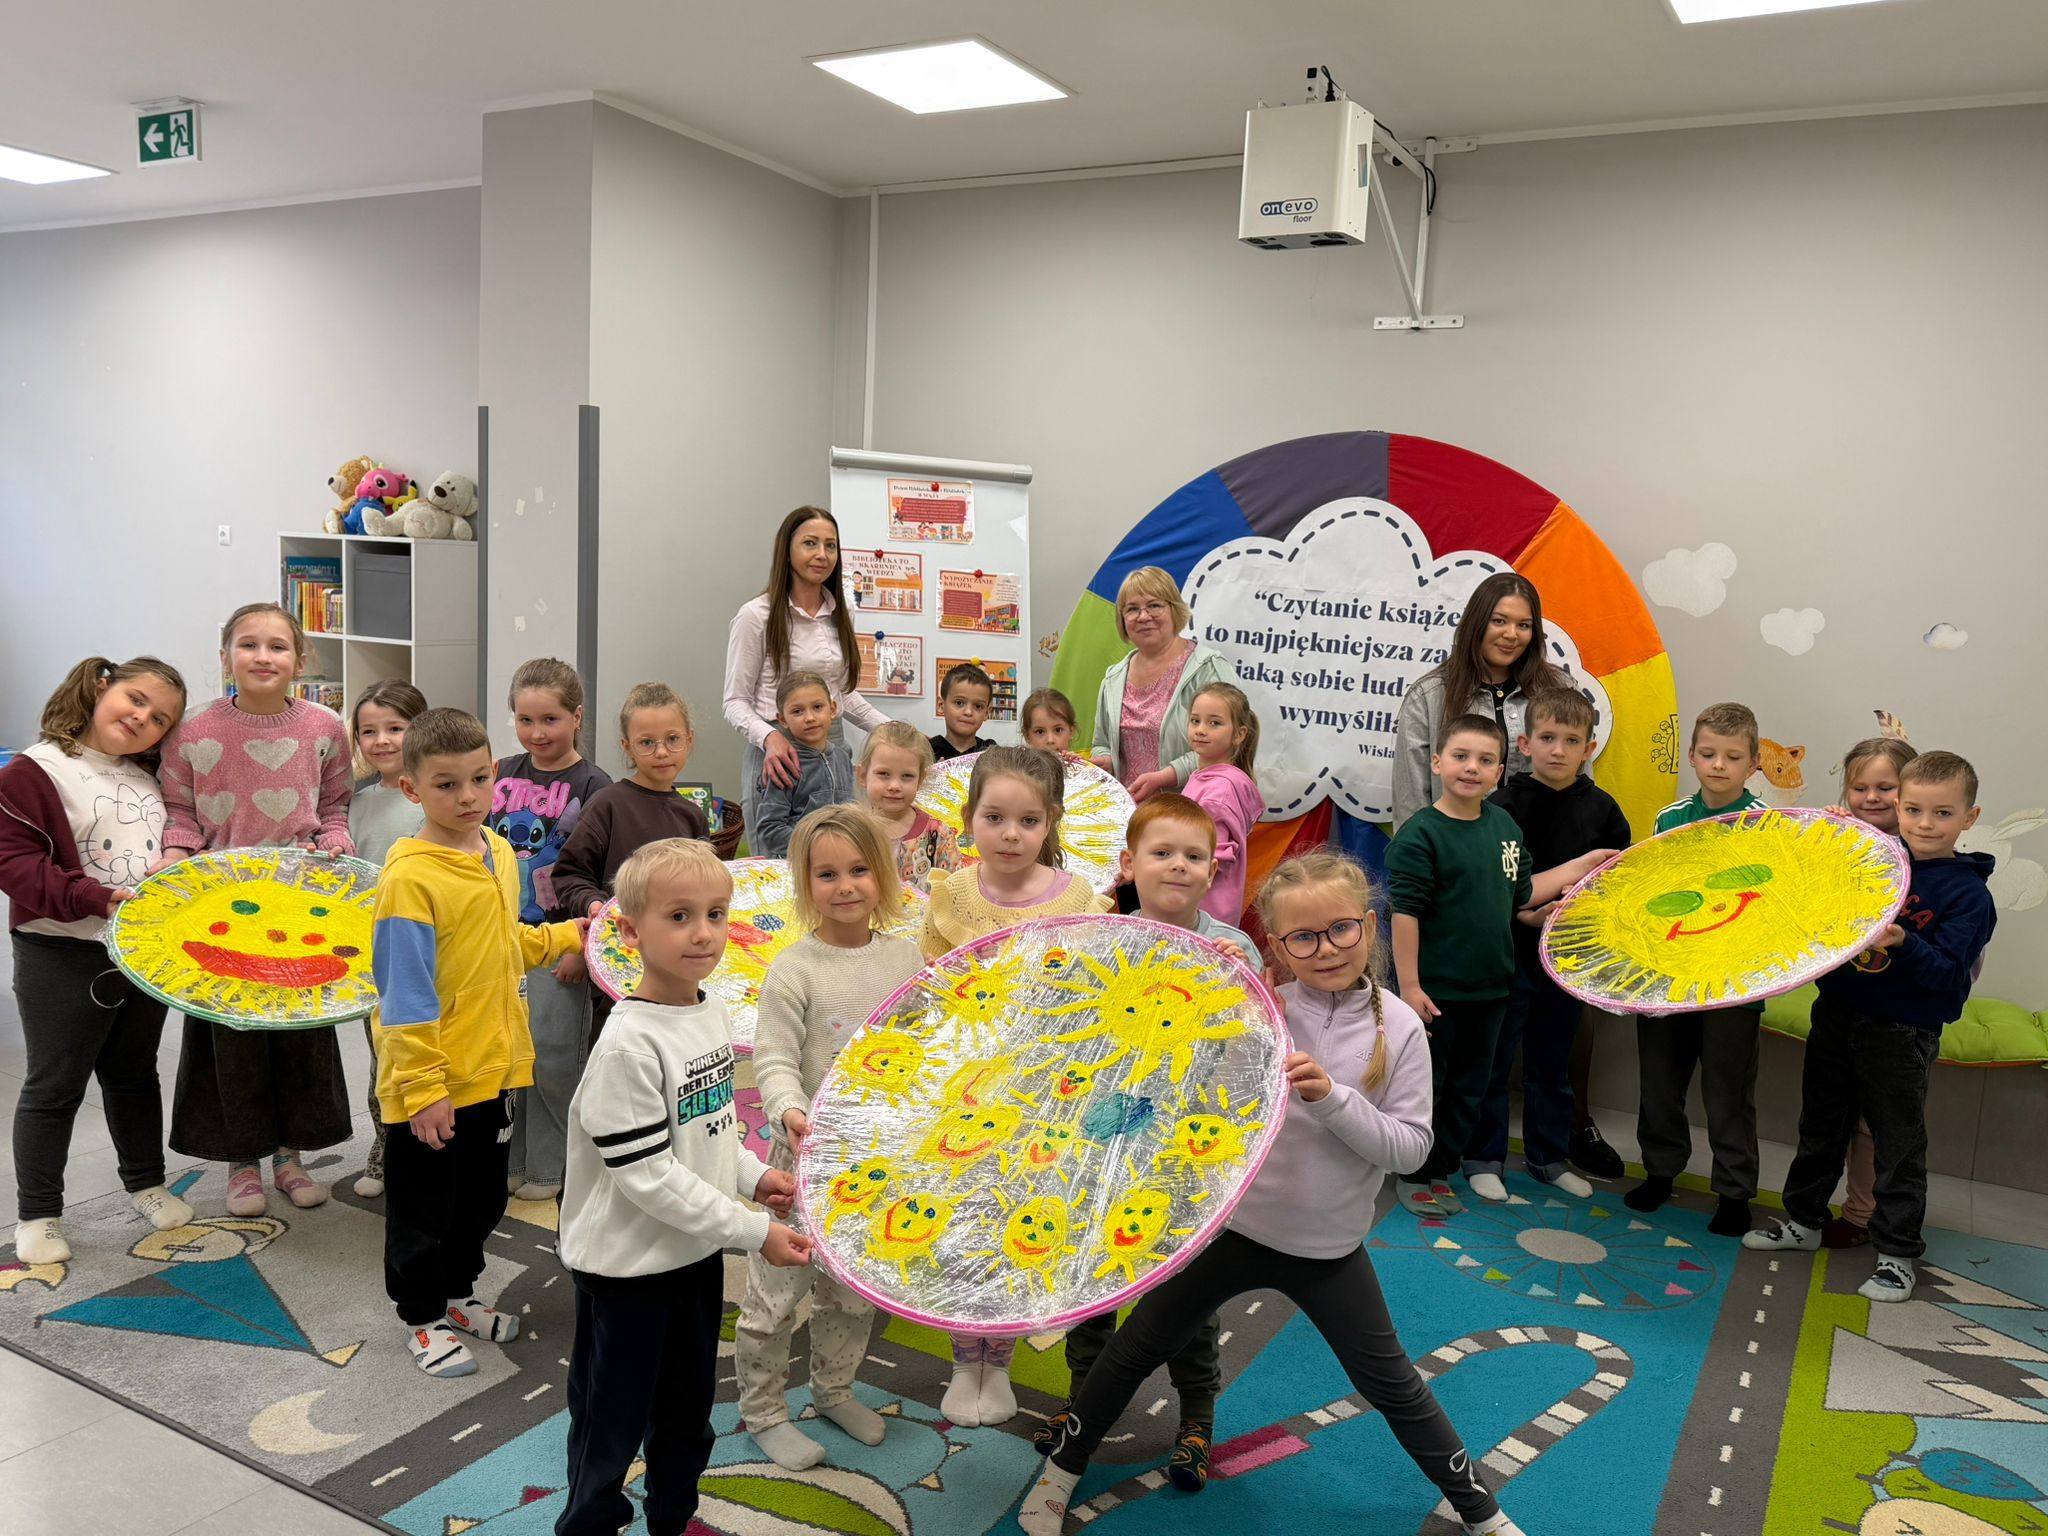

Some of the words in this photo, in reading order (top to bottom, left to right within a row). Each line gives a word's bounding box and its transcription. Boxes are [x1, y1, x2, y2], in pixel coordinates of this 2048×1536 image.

[1293, 215, 1312, 223] floor
[1379, 601, 1461, 631] książe
[1204, 624, 1229, 643] to
[1235, 627, 1413, 663] najpiękniejsza
[1420, 646, 1450, 664] za
[1290, 669, 1355, 692] sobie
[1361, 674, 1411, 698] lud
[1358, 743, 1395, 759] Wisła
